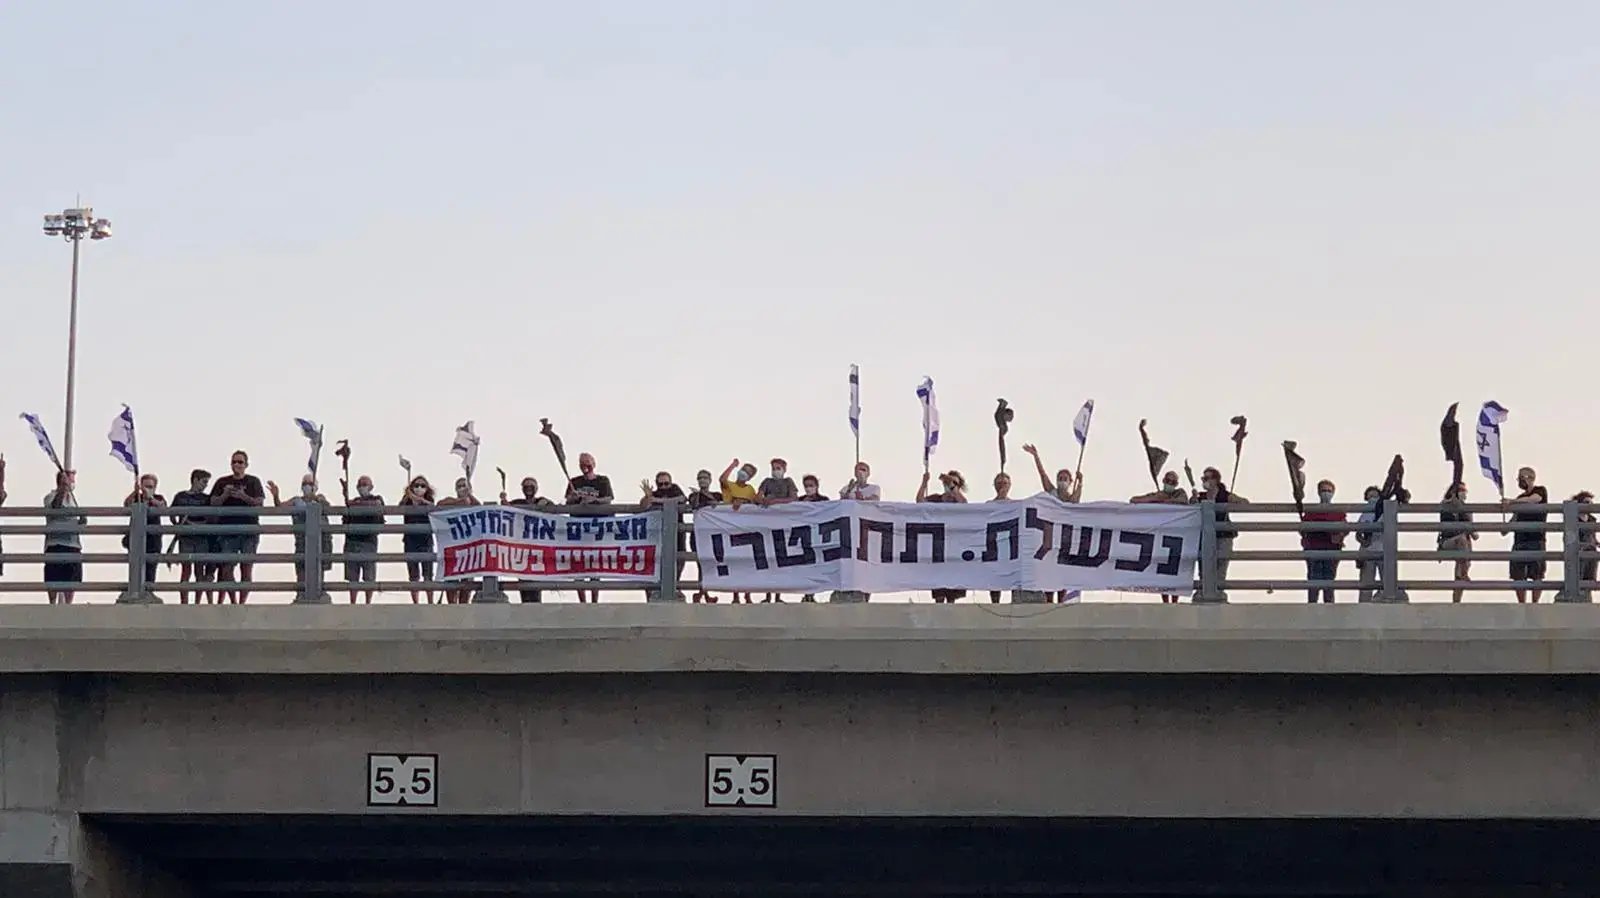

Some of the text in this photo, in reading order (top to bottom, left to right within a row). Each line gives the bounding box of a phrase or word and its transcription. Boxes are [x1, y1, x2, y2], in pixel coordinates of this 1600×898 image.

[447, 510, 648, 540] מצילים את המדינה
[711, 507, 1183, 576] נכשלת. תתפטר!
[555, 549, 646, 571] נלחמים
[374, 767, 432, 794] 5.5
[712, 767, 770, 795] 5.5
